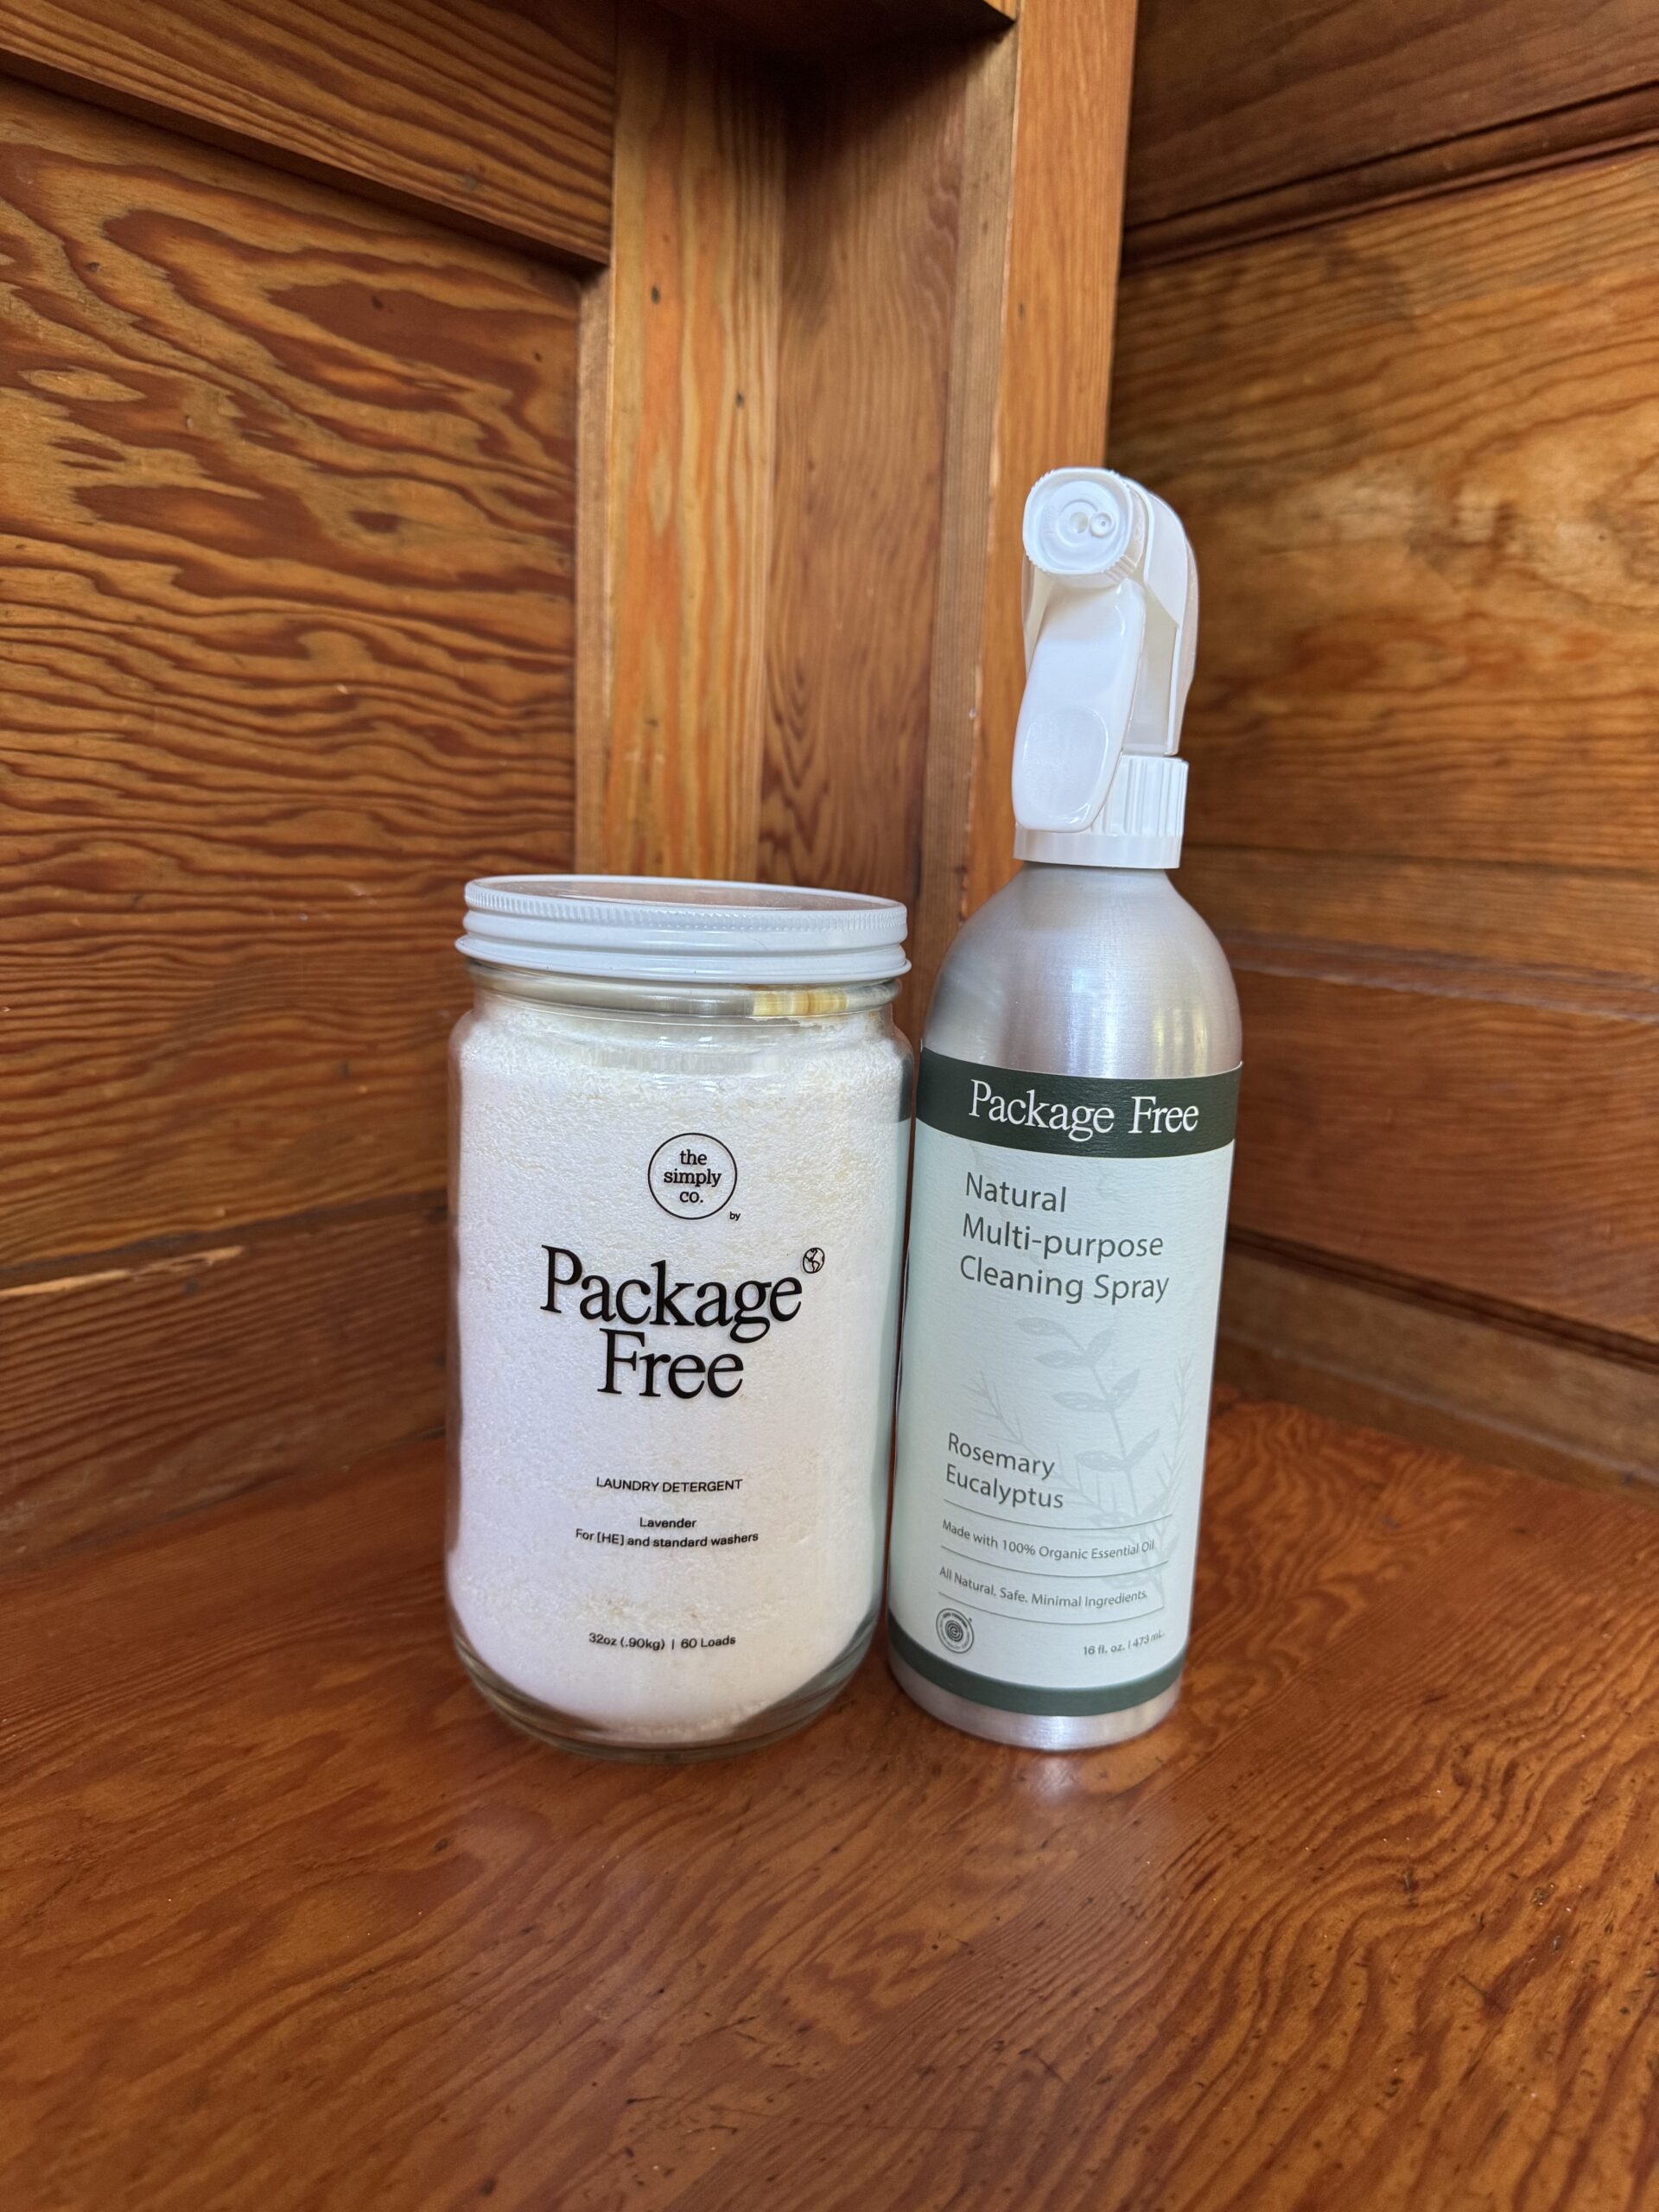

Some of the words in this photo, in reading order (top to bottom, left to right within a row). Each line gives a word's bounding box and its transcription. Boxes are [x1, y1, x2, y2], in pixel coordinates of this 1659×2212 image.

[969, 1079, 1115, 1142] Package
[1128, 1096, 1199, 1134] Free
[663, 1167, 722, 1188] simply
[679, 1148, 708, 1166] the
[679, 1191, 704, 1204] co.
[965, 1172, 1066, 1213] Natural
[729, 1211, 741, 1222] by
[963, 1212, 1164, 1263] Multi-purpose
[540, 1245, 803, 1343] Package
[960, 1255, 1084, 1304] Cleaning
[1093, 1274, 1169, 1305] Spray
[597, 1327, 744, 1399] Free
[949, 1433, 1055, 1481] Rosemary
[596, 1477, 659, 1492] LAUNDRY
[662, 1478, 743, 1493] DETERGENT
[946, 1463, 1064, 1509] Eucalyptus
[575, 1528, 594, 1541] For
[597, 1531, 625, 1547] [HE]
[627, 1536, 650, 1548] and
[652, 1536, 708, 1548] standard
[710, 1532, 759, 1546] washers
[639, 1516, 696, 1529] Lavender
[942, 1518, 970, 1540] Made
[973, 1534, 998, 1548] with
[1002, 1540, 1036, 1555] 100%
[1039, 1546, 1088, 1561] Organic
[1091, 1543, 1139, 1559] Essential
[1141, 1539, 1154, 1552] Oil
[939, 1566, 951, 1580] All
[954, 1572, 996, 1597] Natural.
[999, 1587, 1028, 1603] Safe.
[1031, 1592, 1082, 1607] Minimal
[588, 1632, 617, 1646] 32oz
[620, 1637, 665, 1650] (.90kg)
[681, 1637, 697, 1649] 60
[701, 1635, 736, 1648] Loads
[1084, 1645, 1095, 1656] 16
[1133, 1634, 1150, 1648] 473
